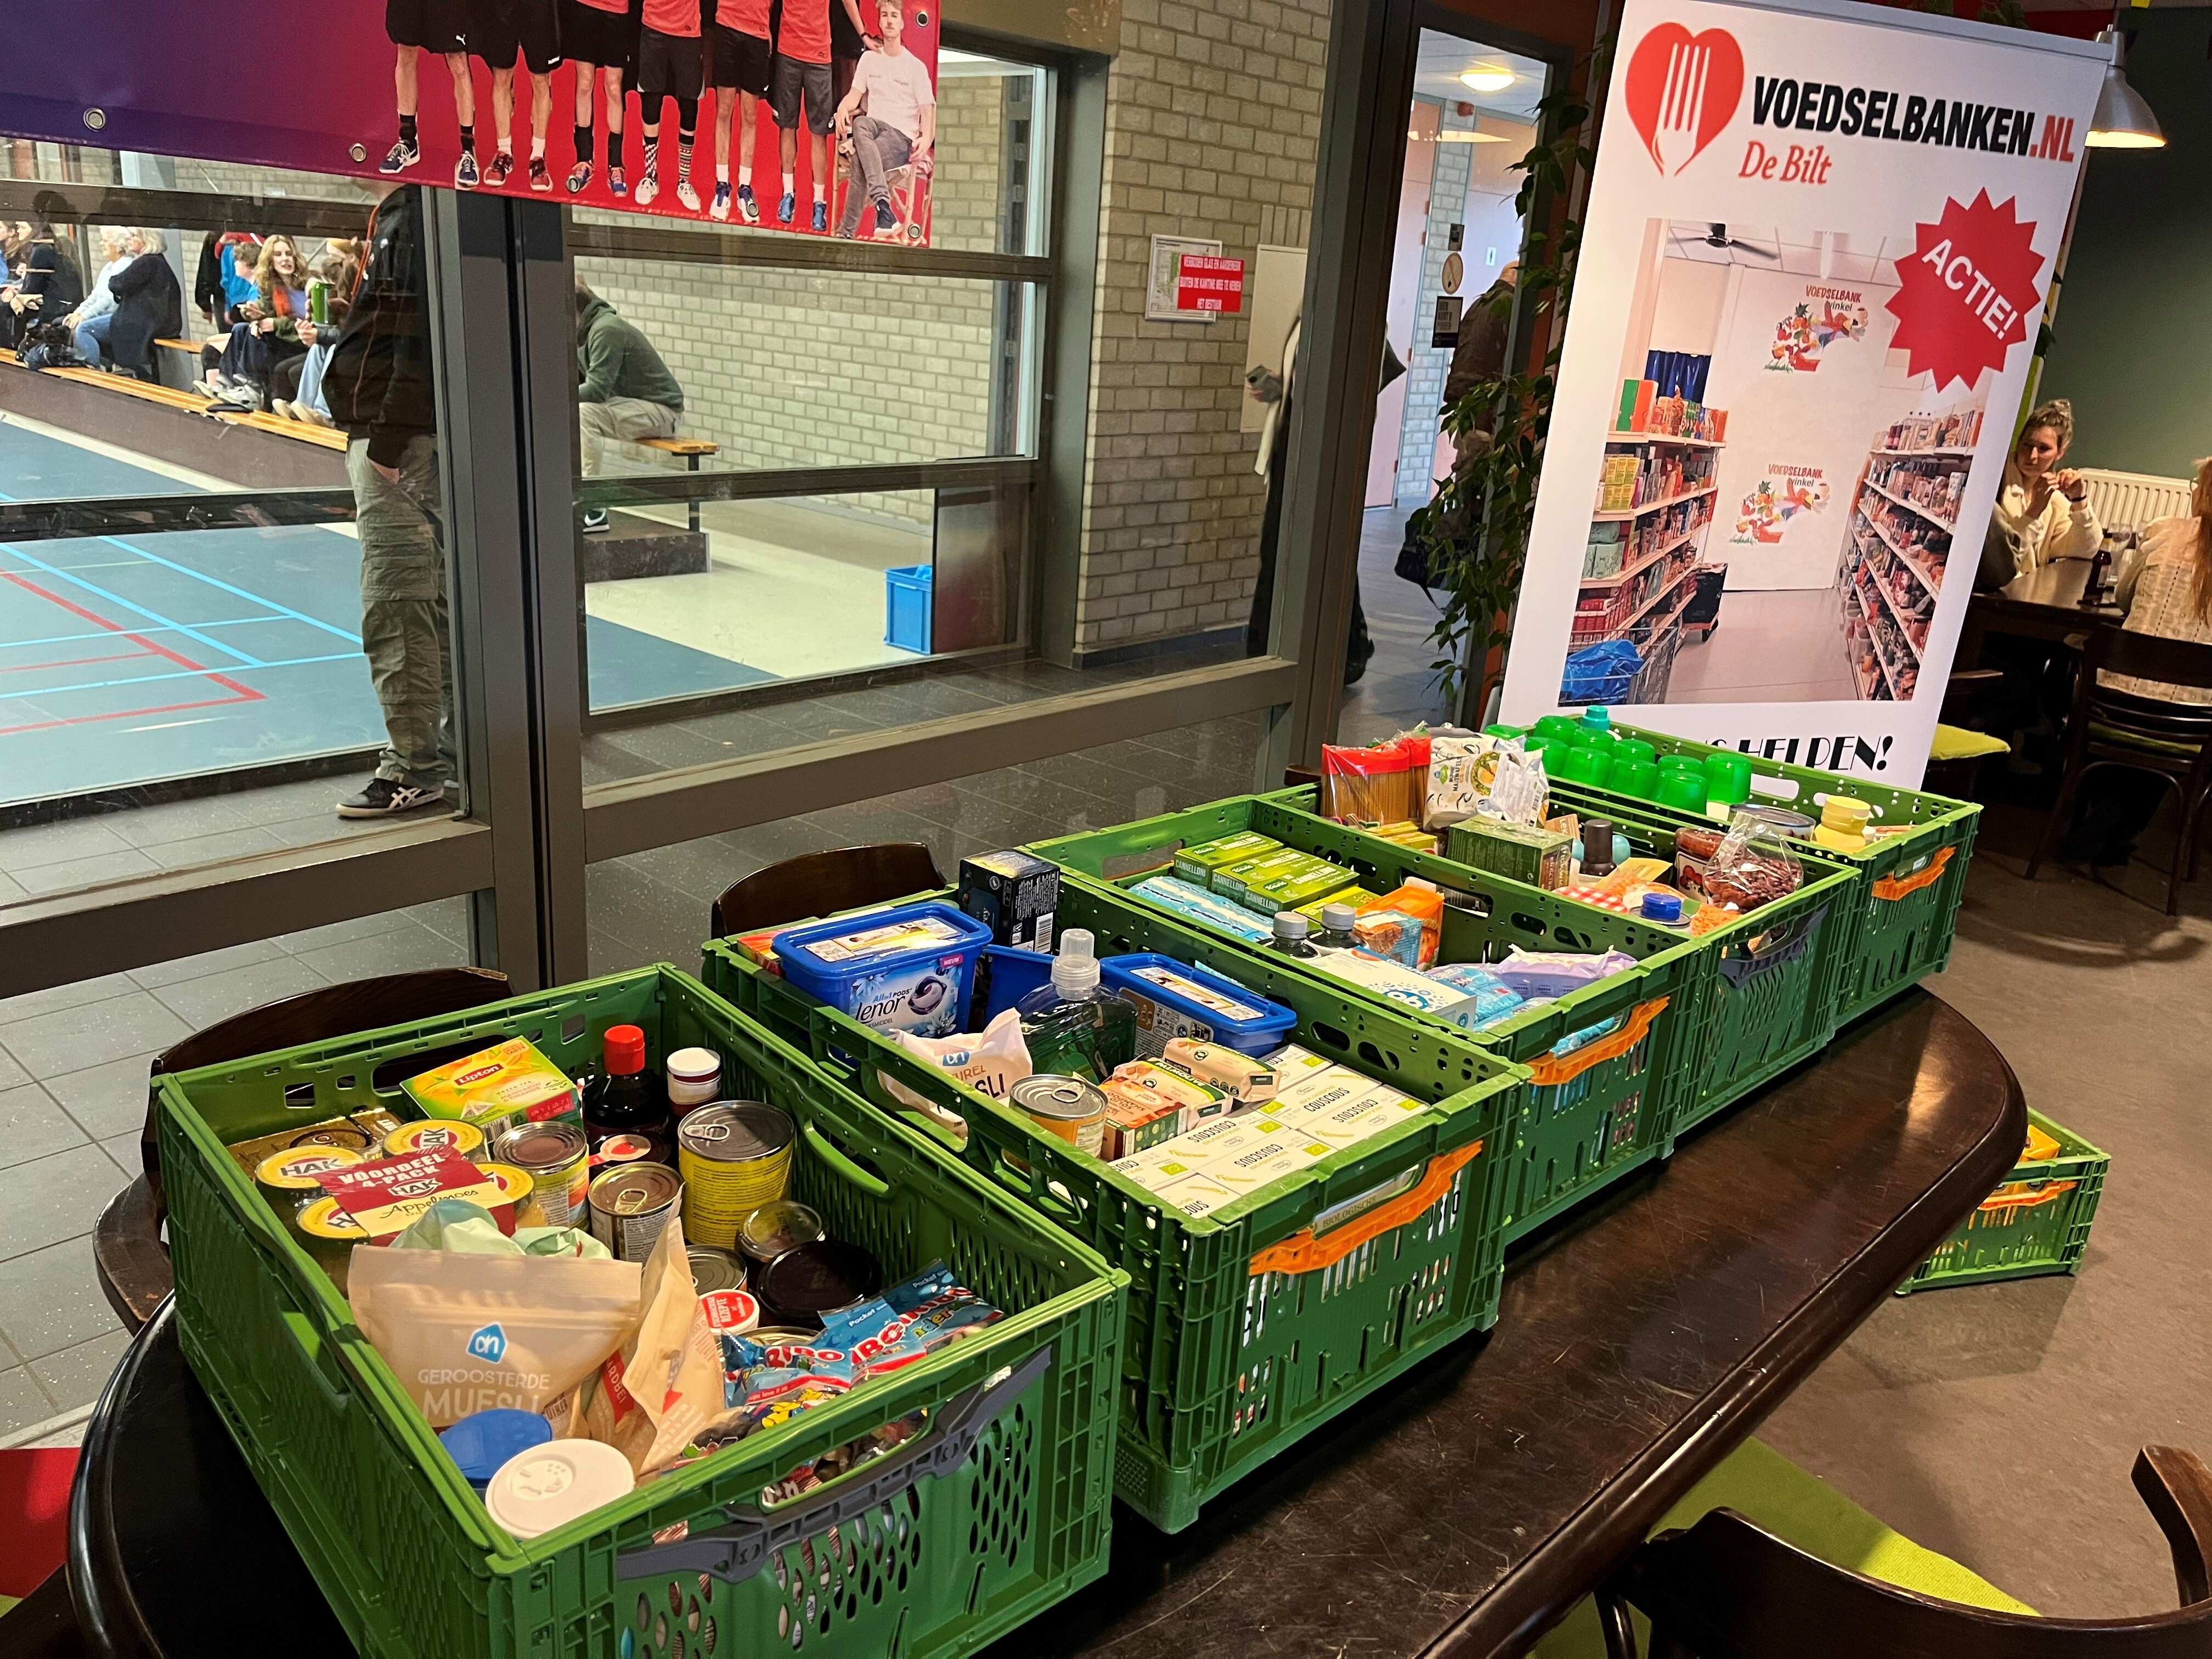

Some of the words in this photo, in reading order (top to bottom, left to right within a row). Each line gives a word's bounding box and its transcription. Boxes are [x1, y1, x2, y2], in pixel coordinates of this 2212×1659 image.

[1753, 75, 2074, 163] VOEDSELBANKEN.NL
[1739, 140, 1778, 180] De
[1780, 144, 1832, 185] Bilt
[1805, 285, 1862, 303] VOEDSELBANK
[1922, 239, 2018, 340] ACTIE!
[1768, 464, 1823, 479] VOEDSELBANK
[1559, 818, 1568, 835] Lek
[1175, 859, 1206, 877] CANNELLONI
[1212, 873, 1245, 893] CANNELLONI
[1245, 890, 1279, 912] CANNELLONI
[943, 956, 961, 966] NIEUW
[865, 1018, 894, 1028] ASMIDDEL
[459, 1065, 500, 1084] Lipton
[954, 1065, 986, 1081] UREL
[1155, 1062, 1206, 1086] PALMOLIVE
[974, 1073, 1005, 1098] SLI
[1304, 1087, 1350, 1112] COUSCOUS
[1332, 1099, 1378, 1122] COUSCOUS
[1187, 1120, 1237, 1143] COUSCOUS
[1234, 1144, 1283, 1167] COUSCOUS
[280, 1158, 345, 1177] HAK
[338, 1153, 445, 1185] VOORDEEL
[362, 1165, 440, 1188] 4-PACK
[389, 1180, 439, 1195] HAK
[380, 1189, 478, 1219] Appelmoes
[1322, 1196, 1376, 1228] BIOLOGISCHE
[912, 1273, 937, 1288] Pocket
[715, 1297, 732, 1323] REZEPTE
[849, 1308, 875, 1327] Pocket
[765, 1346, 845, 1368] RIBO
[417, 1369, 551, 1390] GEROOSTERDE
[607, 1357, 627, 1403] ARDBEI
[546, 1398, 568, 1420] UIKER
